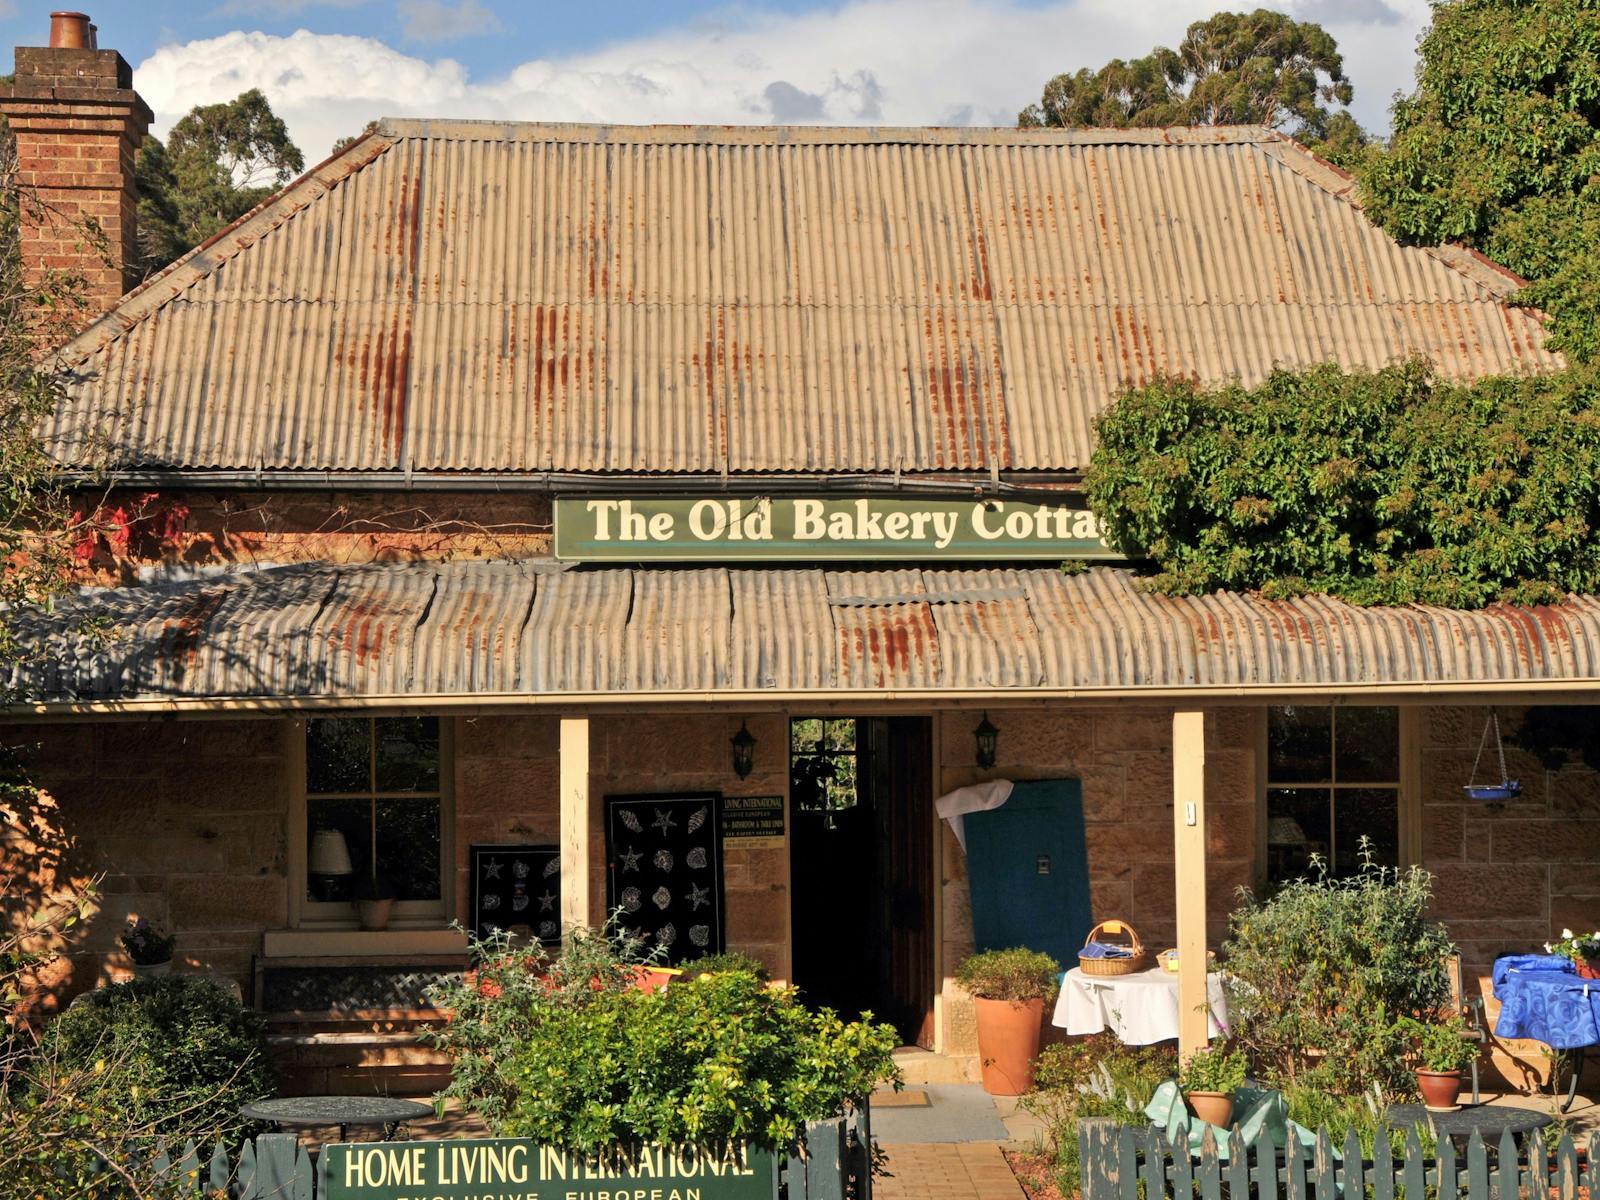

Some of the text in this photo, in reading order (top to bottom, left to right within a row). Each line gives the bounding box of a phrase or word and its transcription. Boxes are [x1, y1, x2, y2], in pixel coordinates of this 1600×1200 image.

[587, 499, 675, 542] The
[688, 499, 774, 542] Old
[792, 499, 958, 549] Bakery
[724, 799, 742, 809] LIVING
[345, 1138, 754, 1188] HOME LIVING INTERNATIONAL
[566, 1188, 701, 1200] EUROPEAN
